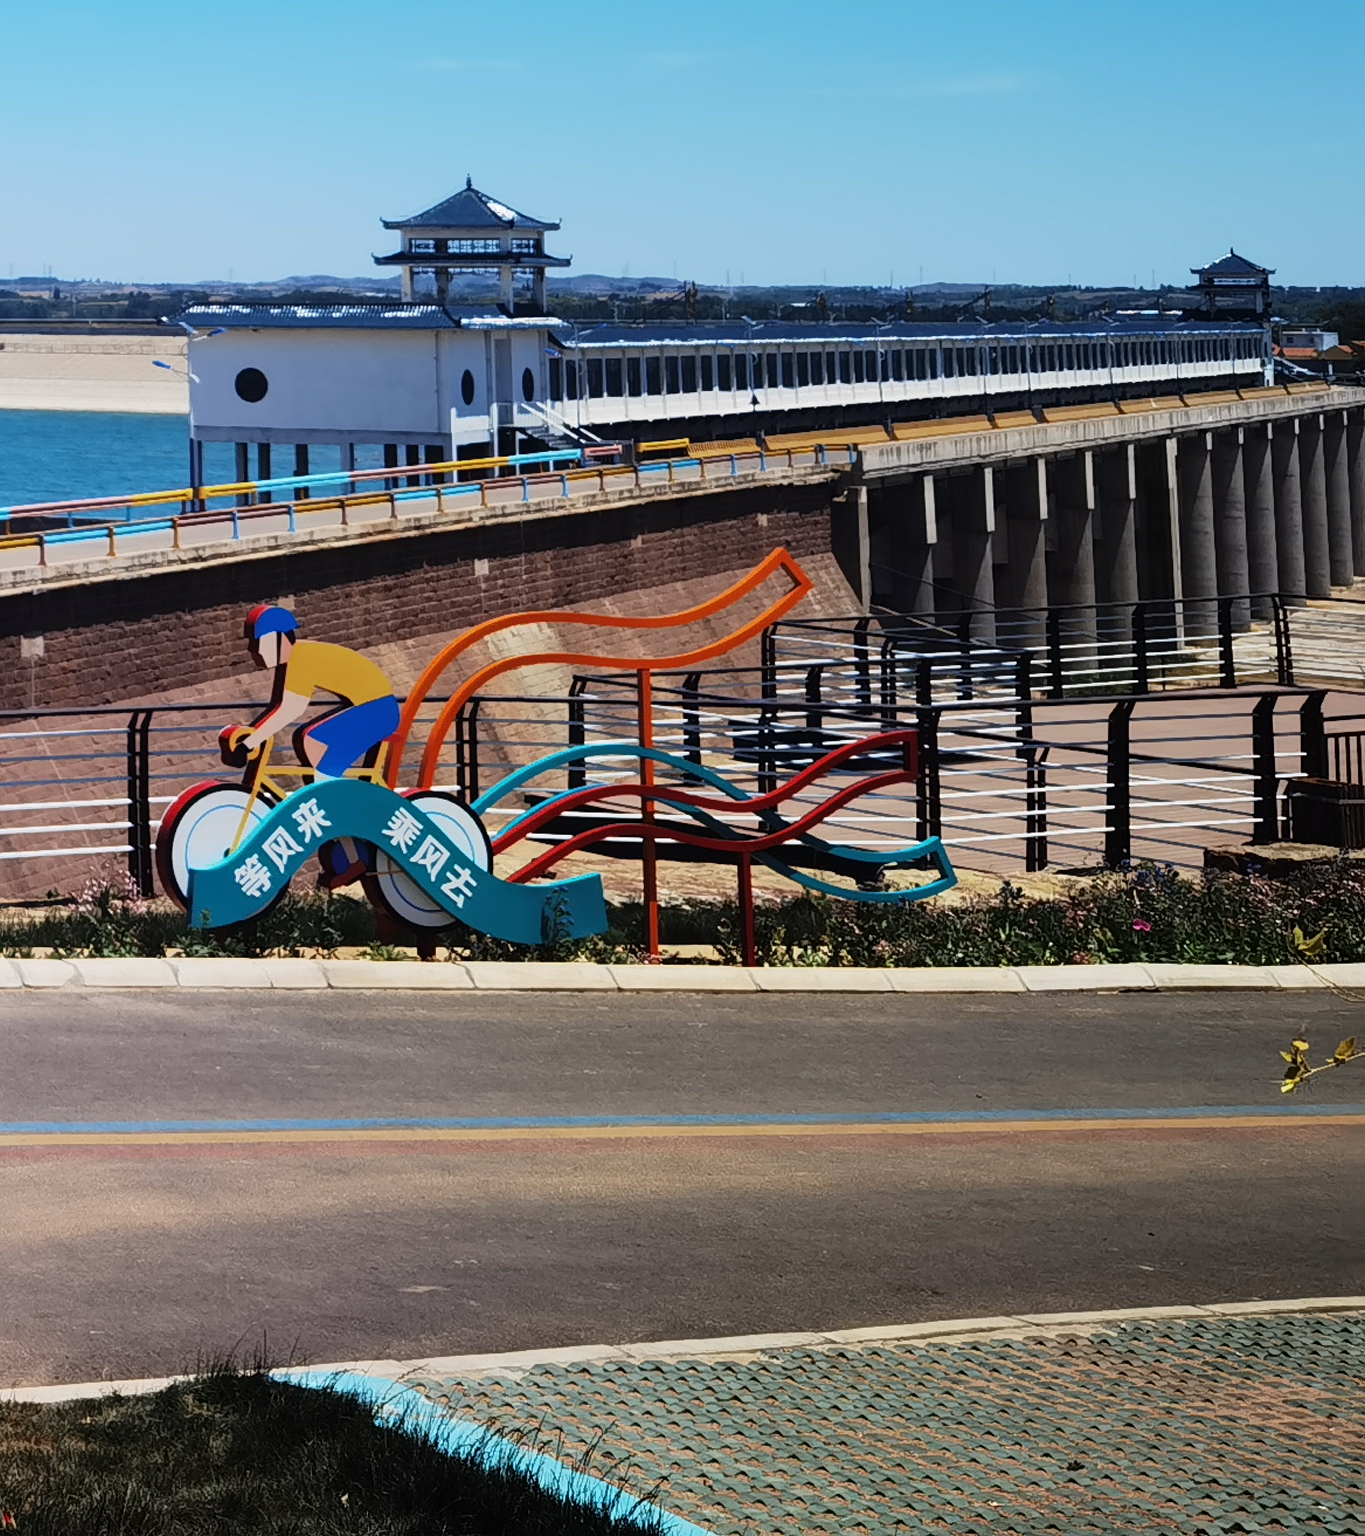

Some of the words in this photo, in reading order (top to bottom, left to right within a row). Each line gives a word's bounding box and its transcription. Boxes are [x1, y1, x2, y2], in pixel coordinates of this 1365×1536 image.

[233, 797, 332, 898] 等风来
[382, 806, 478, 909] 乘风去
